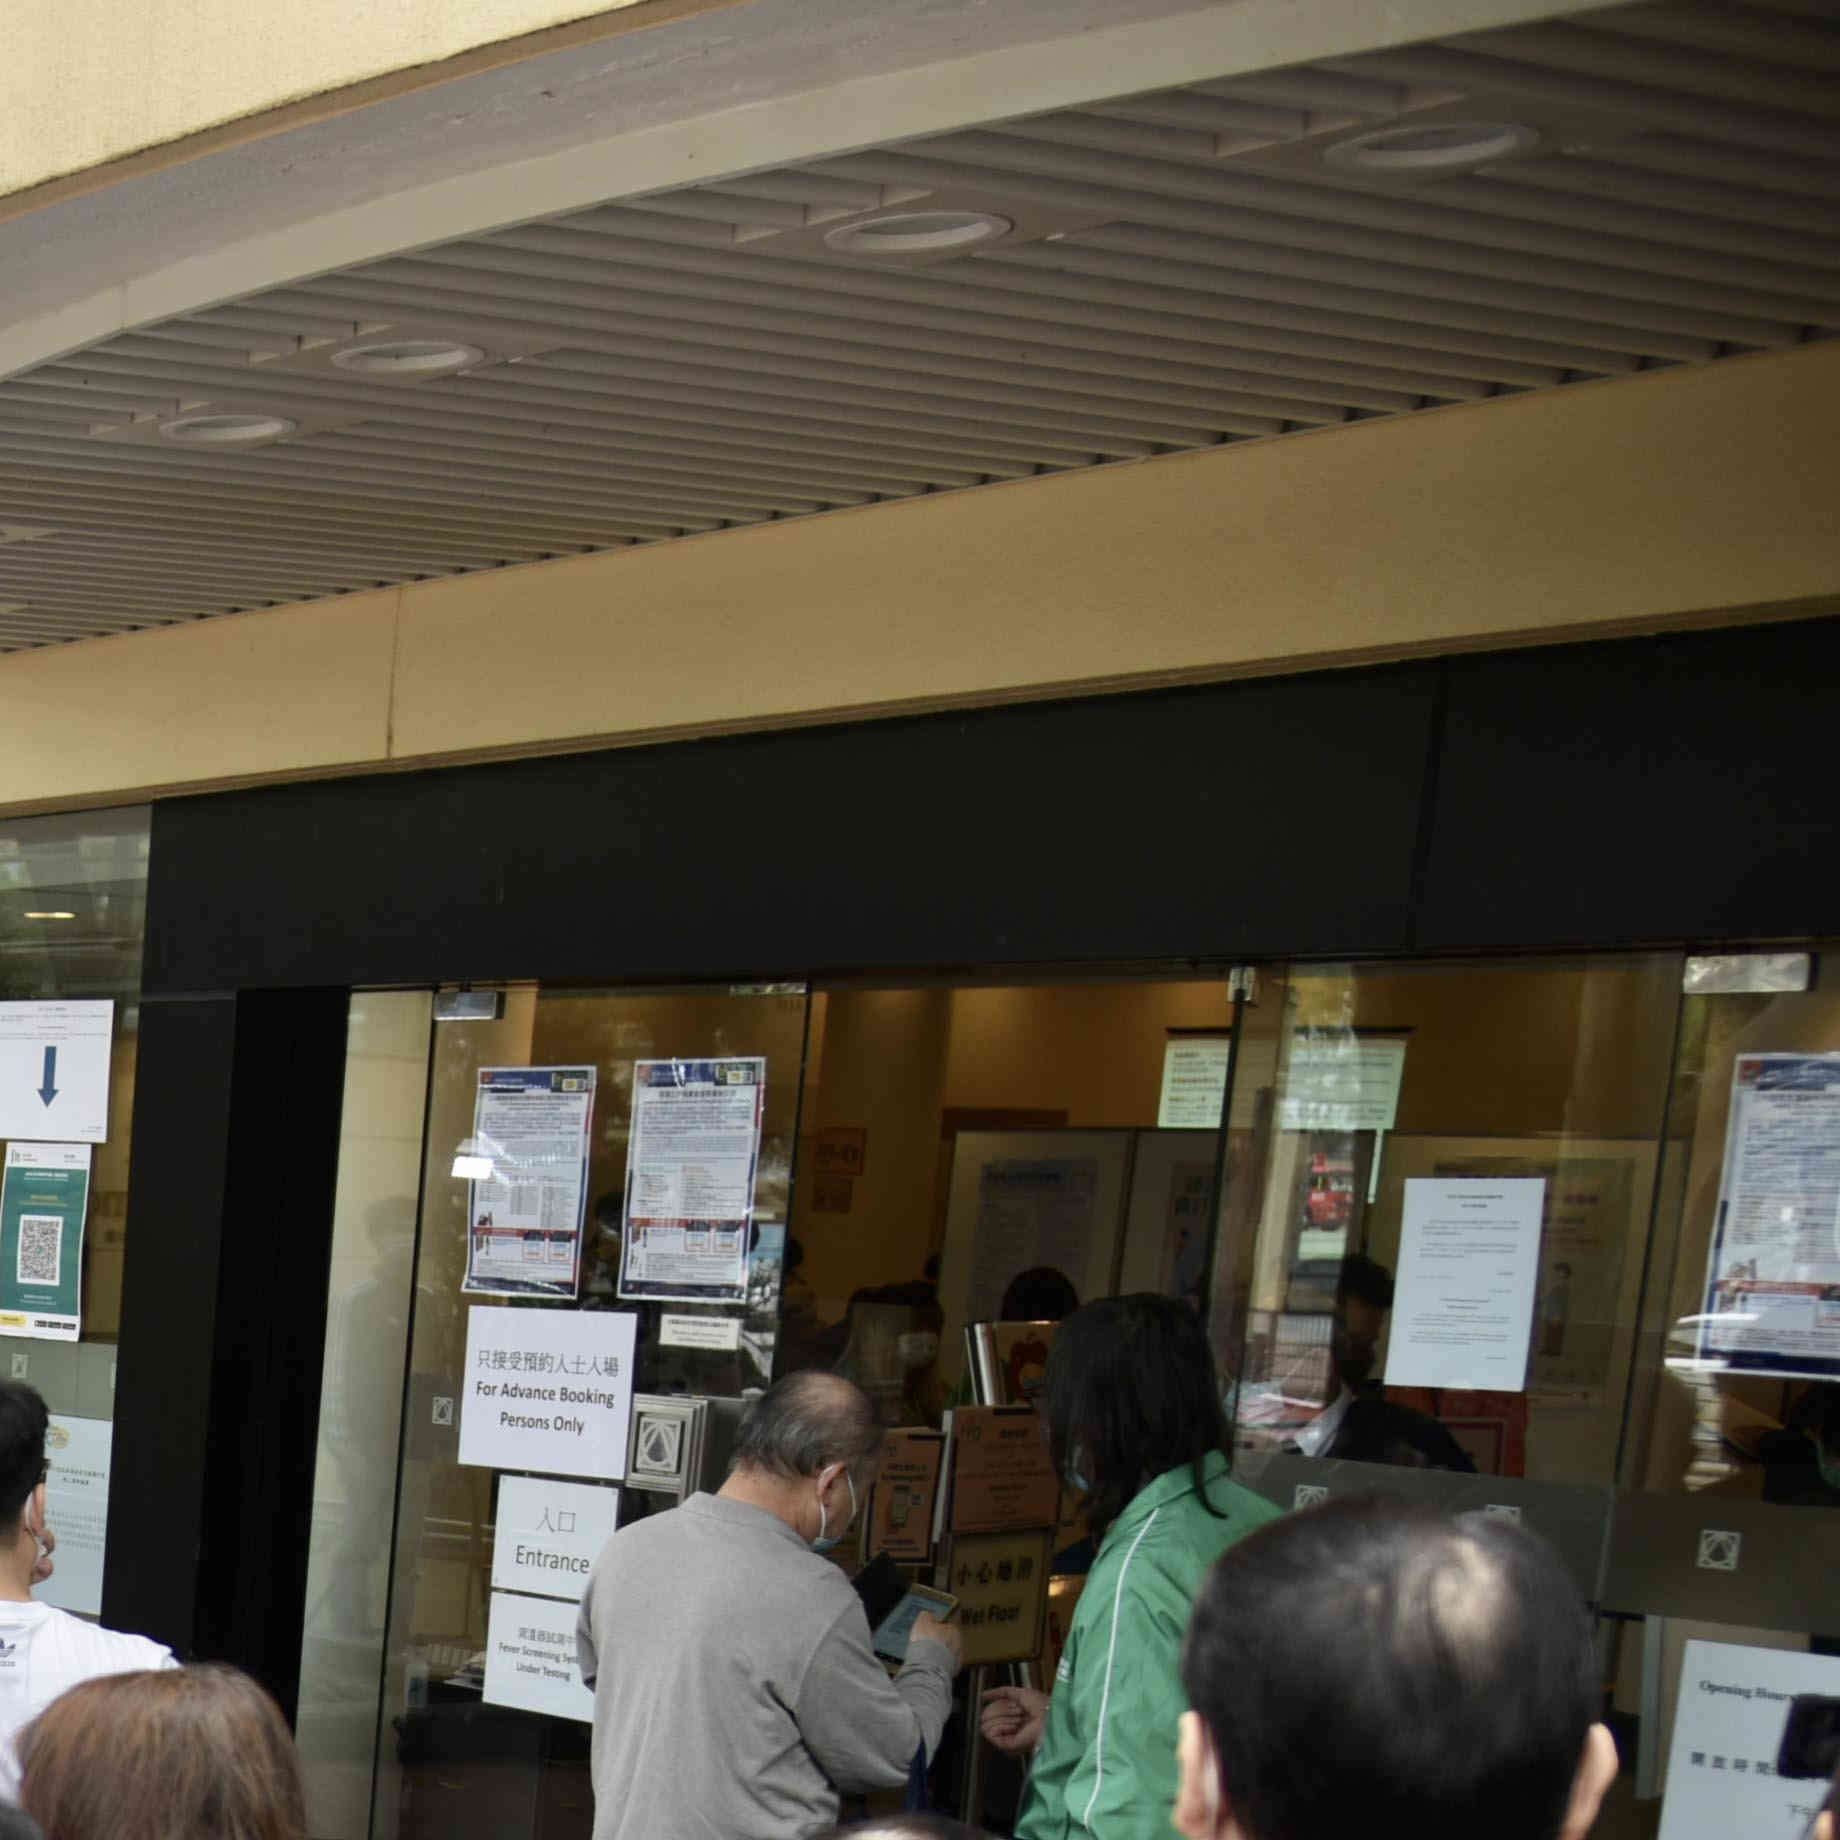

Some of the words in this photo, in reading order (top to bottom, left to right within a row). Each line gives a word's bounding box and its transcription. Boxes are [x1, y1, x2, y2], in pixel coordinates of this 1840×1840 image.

[477, 1349, 620, 1378] 只接受預約人士入場
[476, 1380, 498, 1398] For
[501, 1383, 557, 1402] Advance
[559, 1386, 615, 1409] Booking
[500, 1411, 550, 1430] Persons
[553, 1415, 584, 1436] Only
[536, 1506, 577, 1534] 入口
[515, 1544, 592, 1575] Entrance
[516, 1661, 540, 1674] Under
[542, 1666, 570, 1681] Testing
